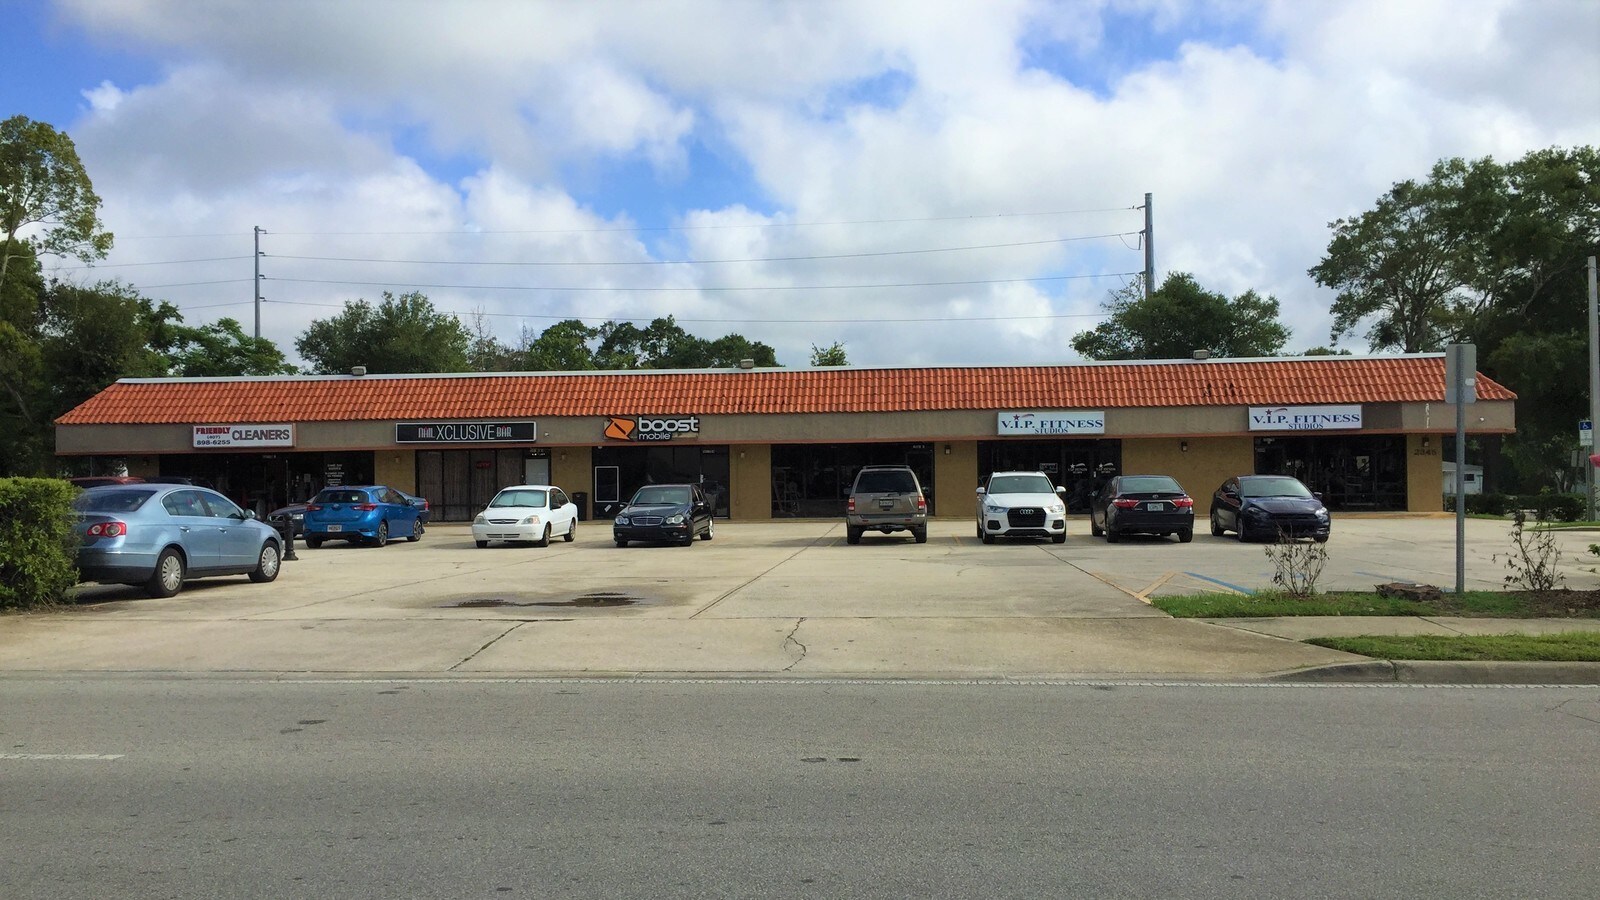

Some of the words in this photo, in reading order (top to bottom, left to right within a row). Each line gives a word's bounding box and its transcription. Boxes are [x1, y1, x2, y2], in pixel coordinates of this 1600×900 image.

[638, 416, 699, 432] boost
[1001, 420, 1035, 429] V.I.P.
[1040, 419, 1103, 428] FITNESS
[1253, 415, 1289, 424] V.I.P.
[1294, 414, 1360, 424] FITNESS
[196, 427, 231, 435] FRIENDLY
[231, 429, 290, 441] CLEANERS
[436, 424, 495, 440] XCLUSIVE
[496, 425, 512, 437] BAR
[638, 432, 671, 440] mobile
